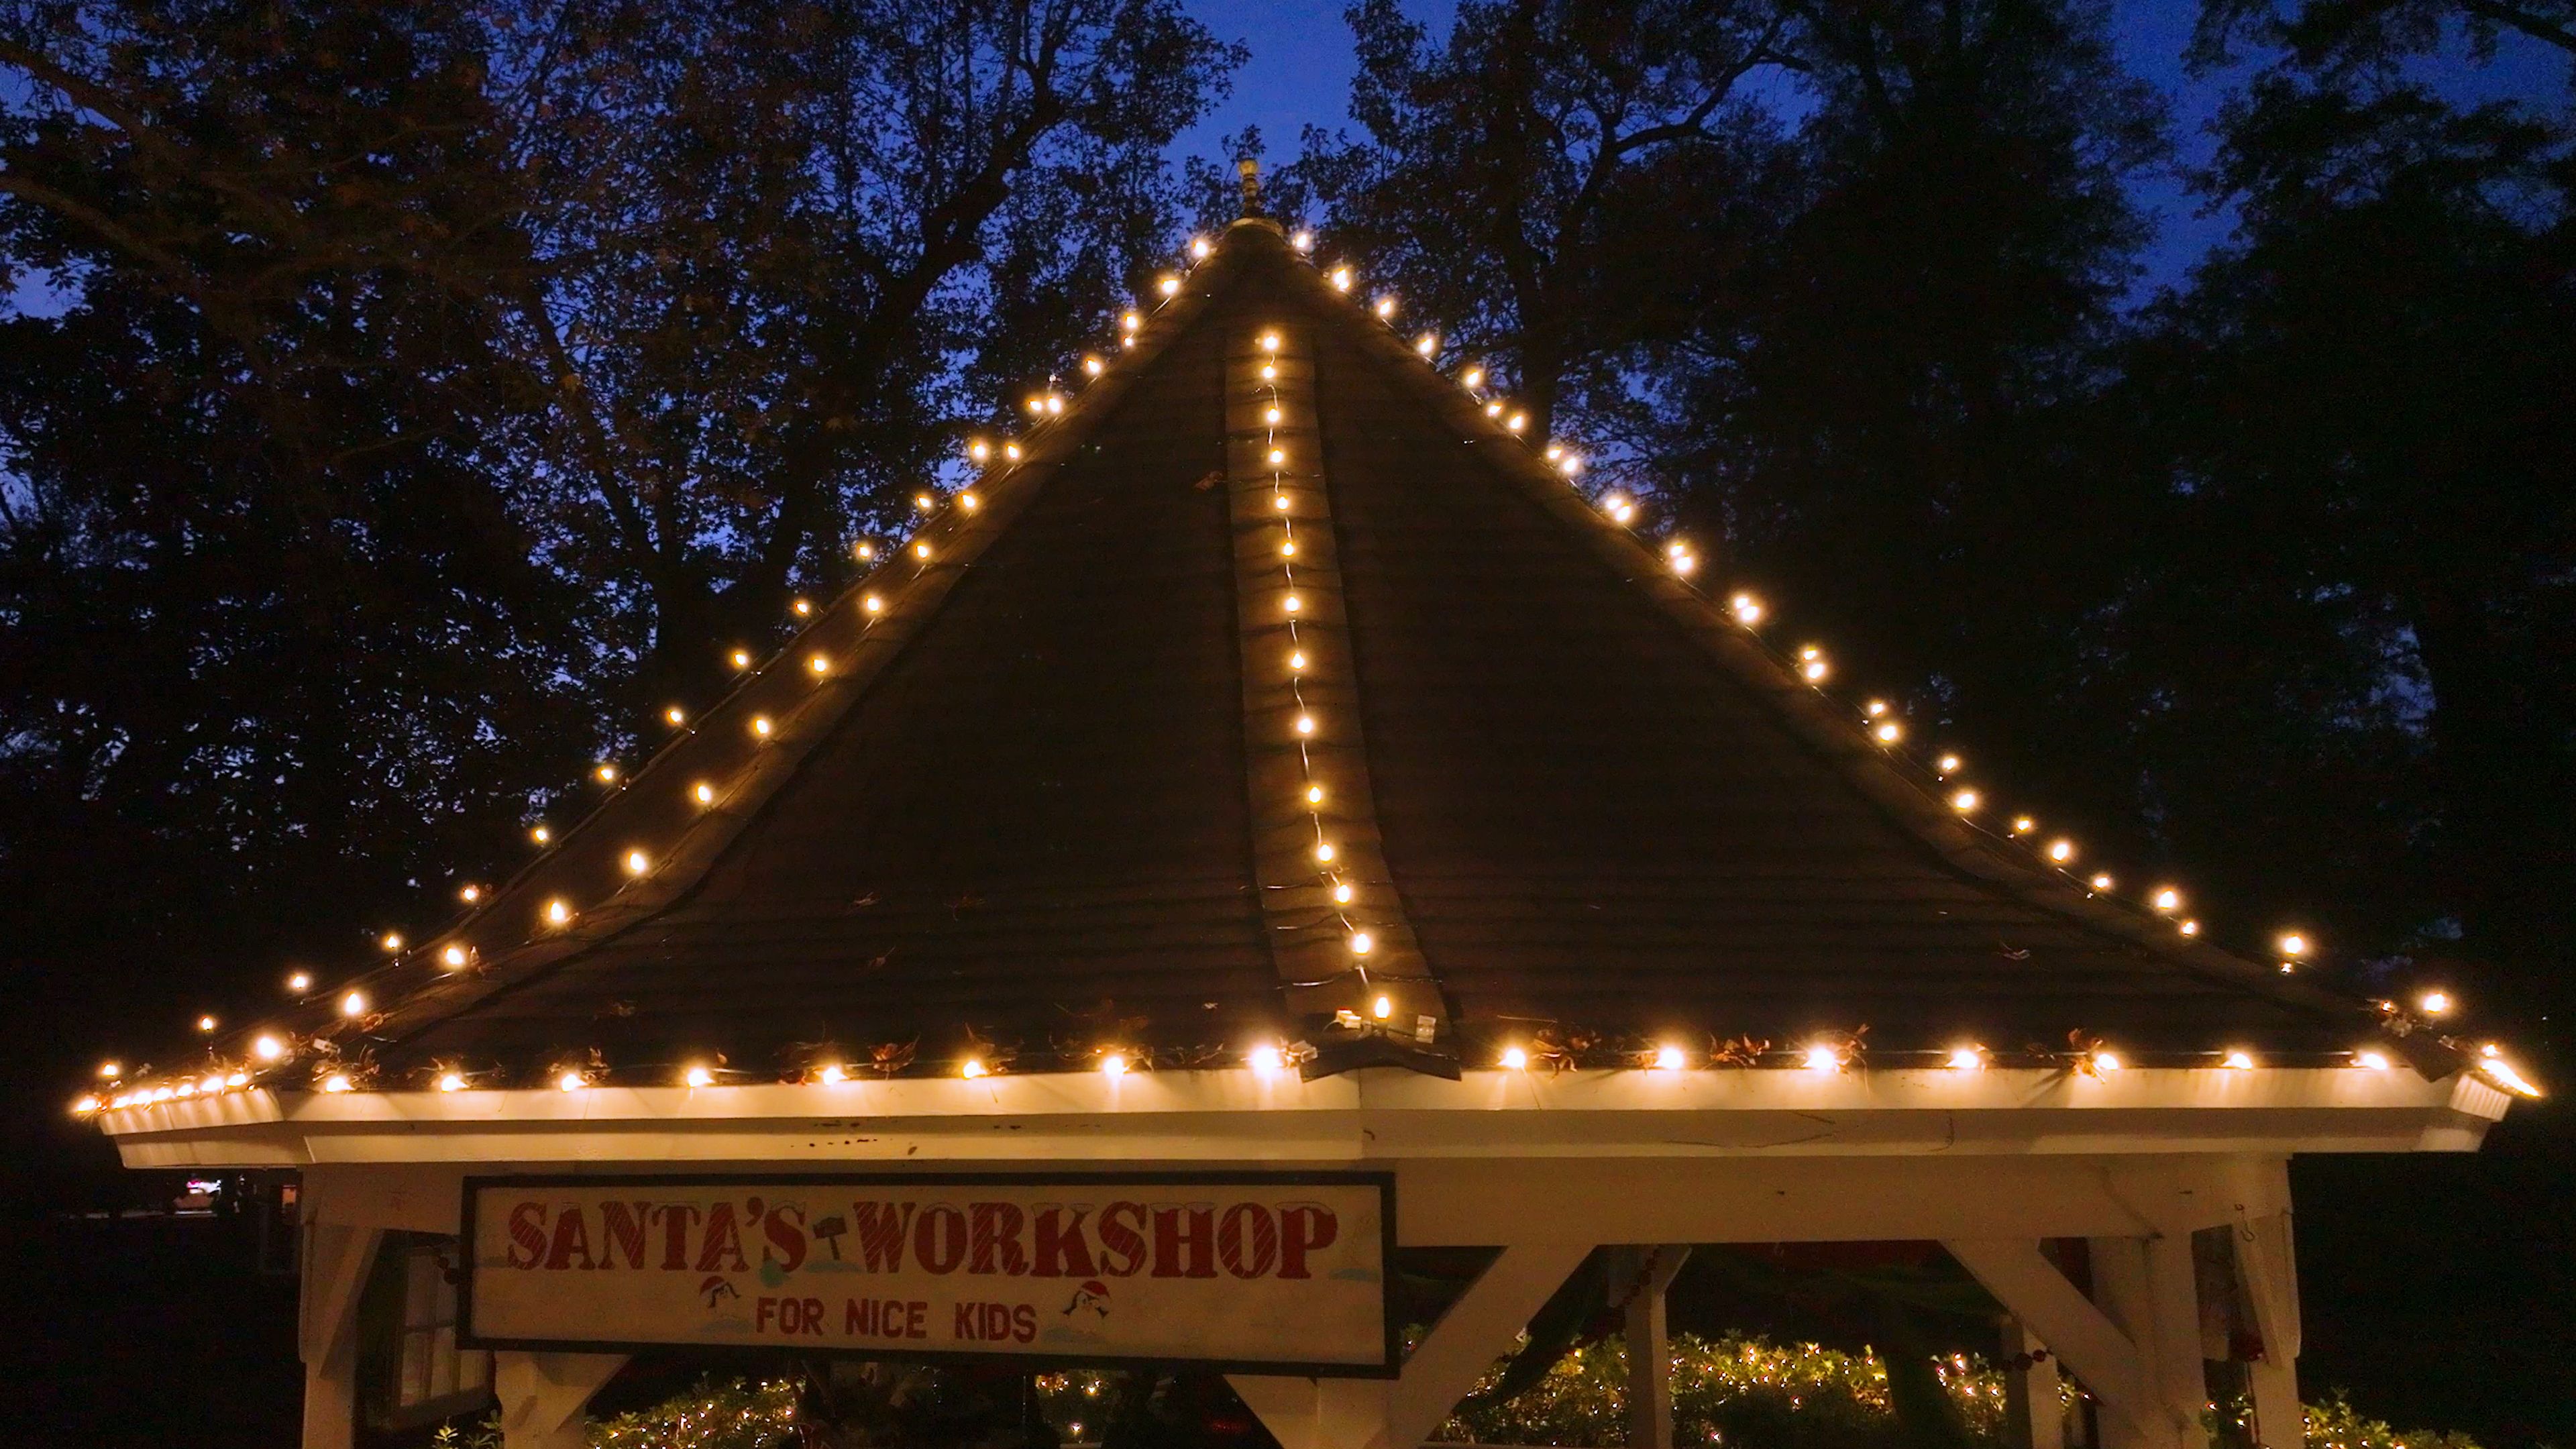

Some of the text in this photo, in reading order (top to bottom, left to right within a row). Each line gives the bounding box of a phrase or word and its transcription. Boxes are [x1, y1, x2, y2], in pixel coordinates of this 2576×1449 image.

[507, 1197, 1338, 1279] SANTA'S WORKSHOP
[757, 1297, 1036, 1343] FOR NICE KIDS
